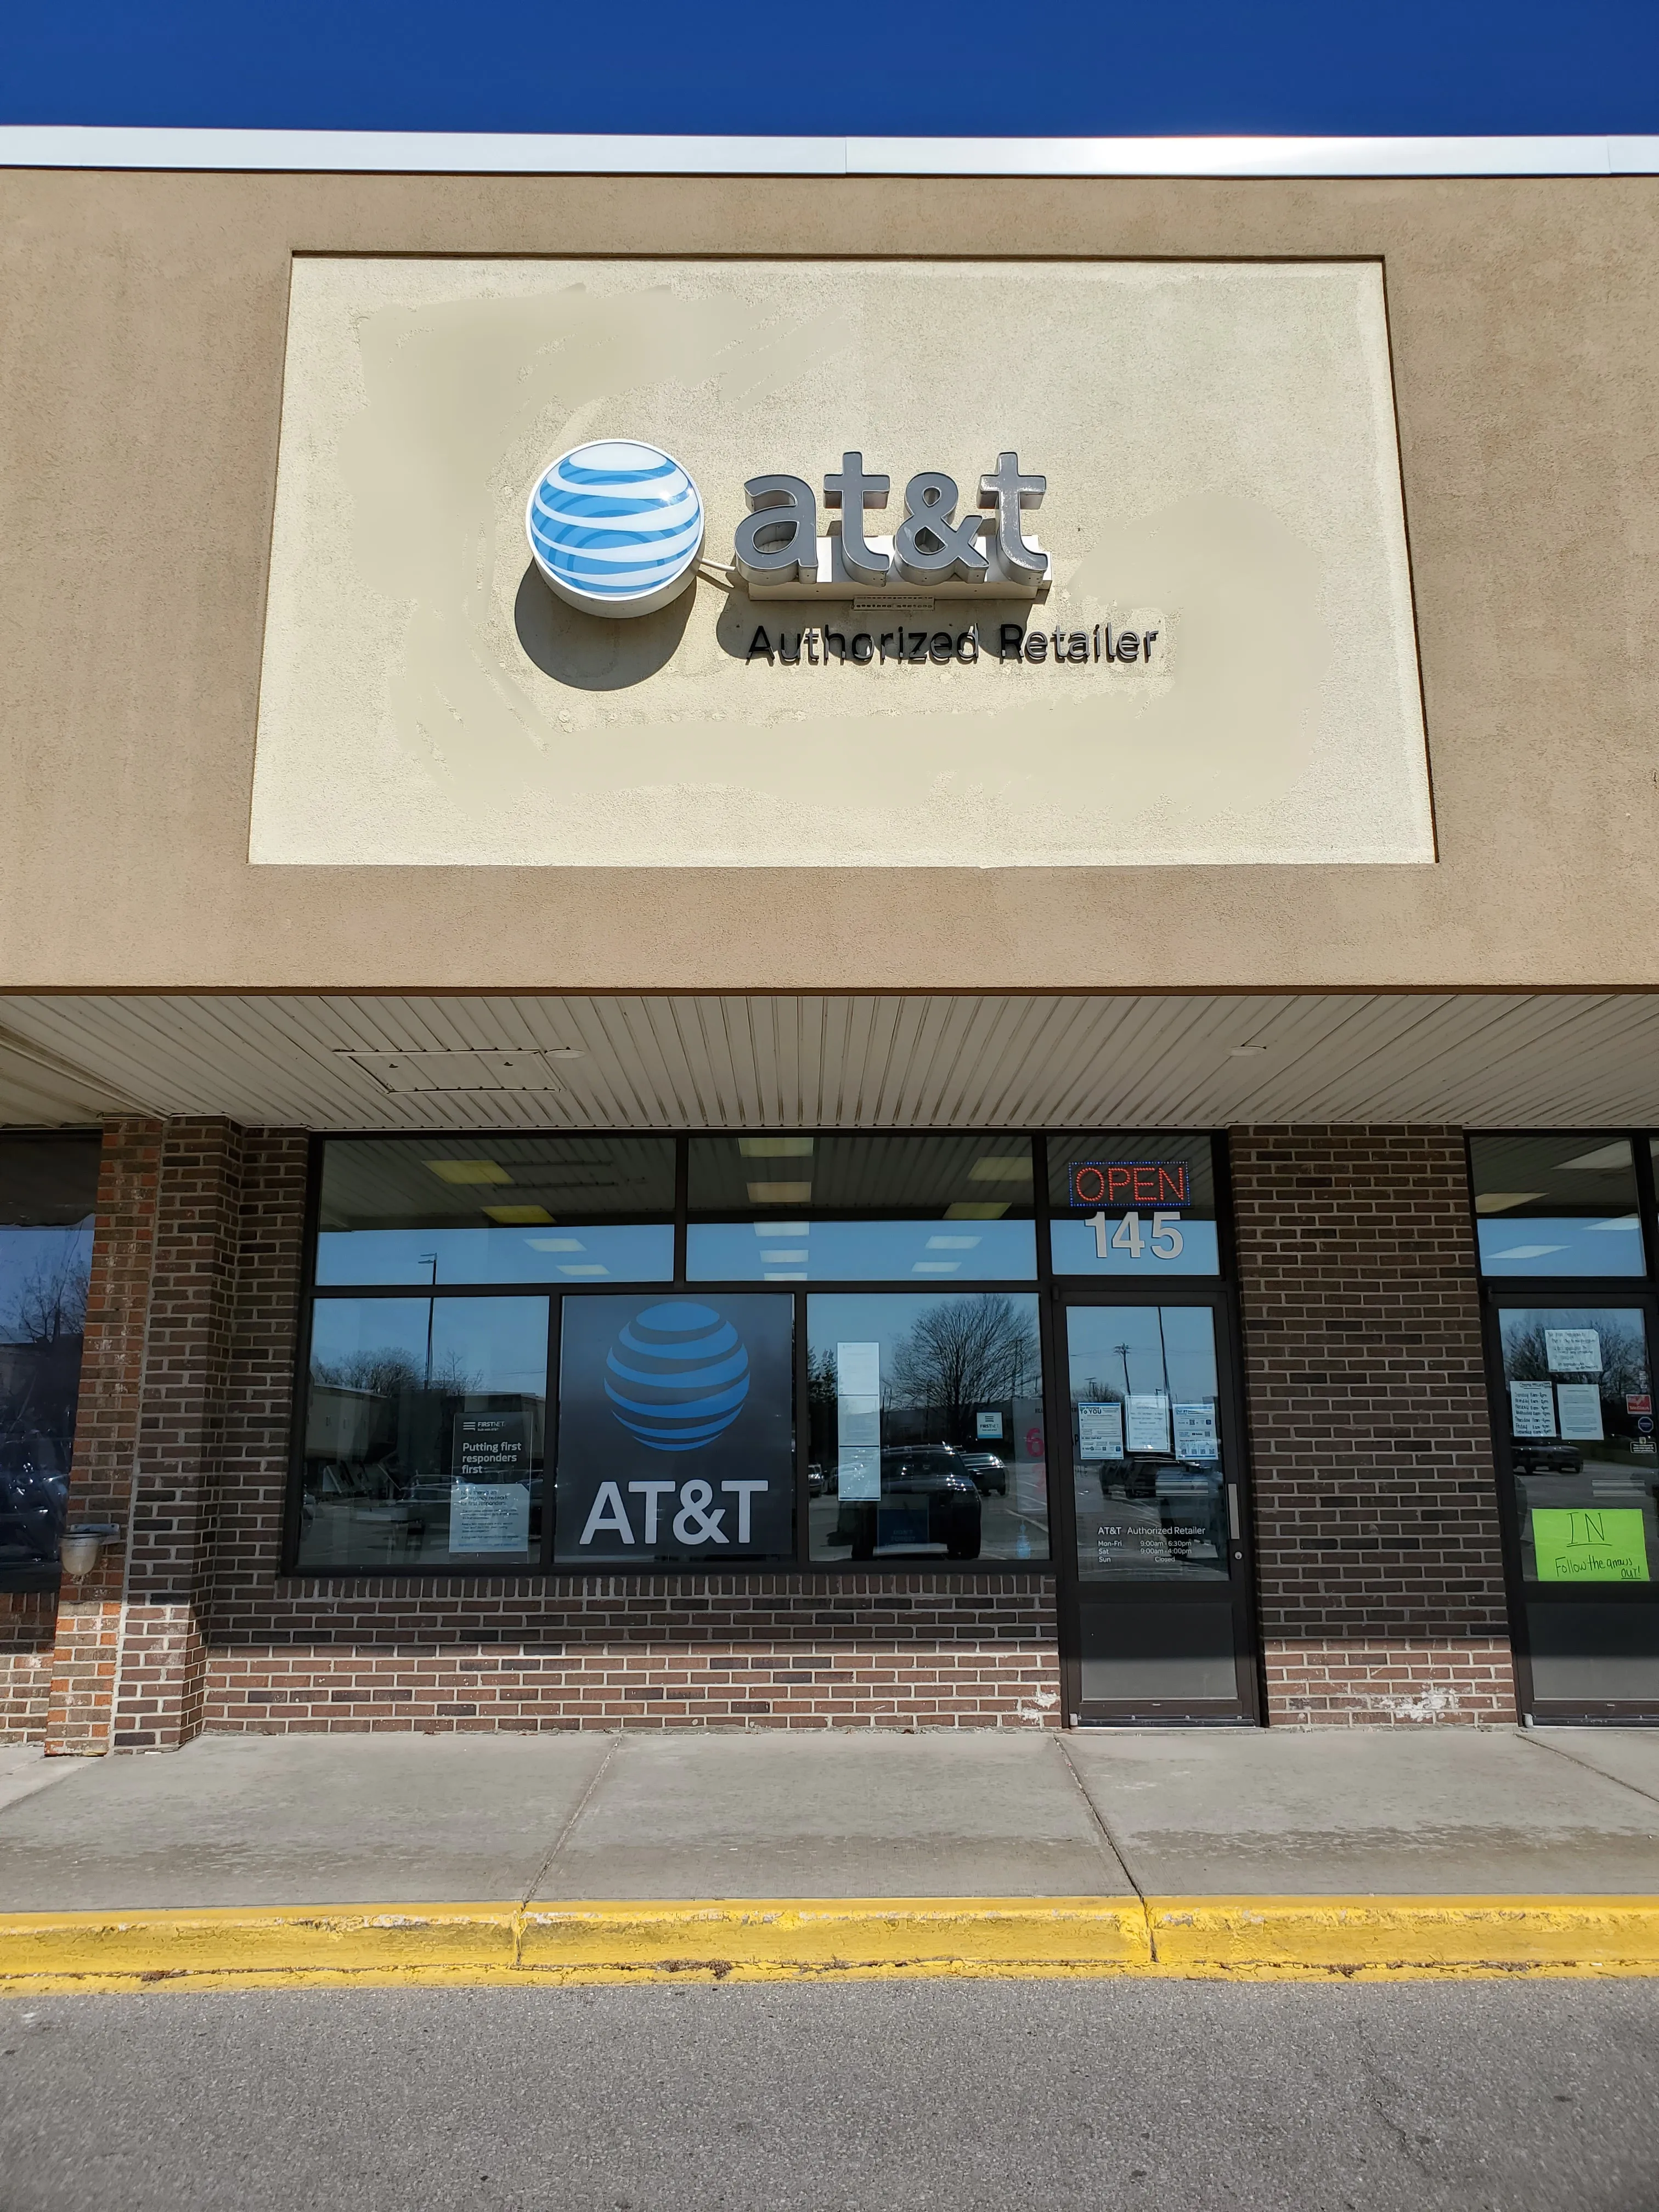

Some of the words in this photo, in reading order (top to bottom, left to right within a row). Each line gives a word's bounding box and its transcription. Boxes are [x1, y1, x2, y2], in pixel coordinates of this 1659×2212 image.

[734, 452, 1048, 575] at&t
[747, 623, 979, 661] Authorized
[1000, 622, 1159, 661] Retailer
[1075, 1167, 1184, 1201] OPEN
[1084, 1211, 1184, 1259] 145
[462, 1442, 499, 1453] Putting
[500, 1441, 522, 1451] first
[1026, 1427, 1045, 1457] 6
[461, 1464, 483, 1474] first
[462, 1453, 517, 1464] responders
[579, 1479, 769, 1545] AT&T
[1567, 1512, 1605, 1545] IN
[1555, 1556, 1587, 1577] Follow
[1587, 1554, 1606, 1571] the
[1606, 1558, 1633, 1568] arrows
[1621, 1565, 1641, 1578] OUT!
